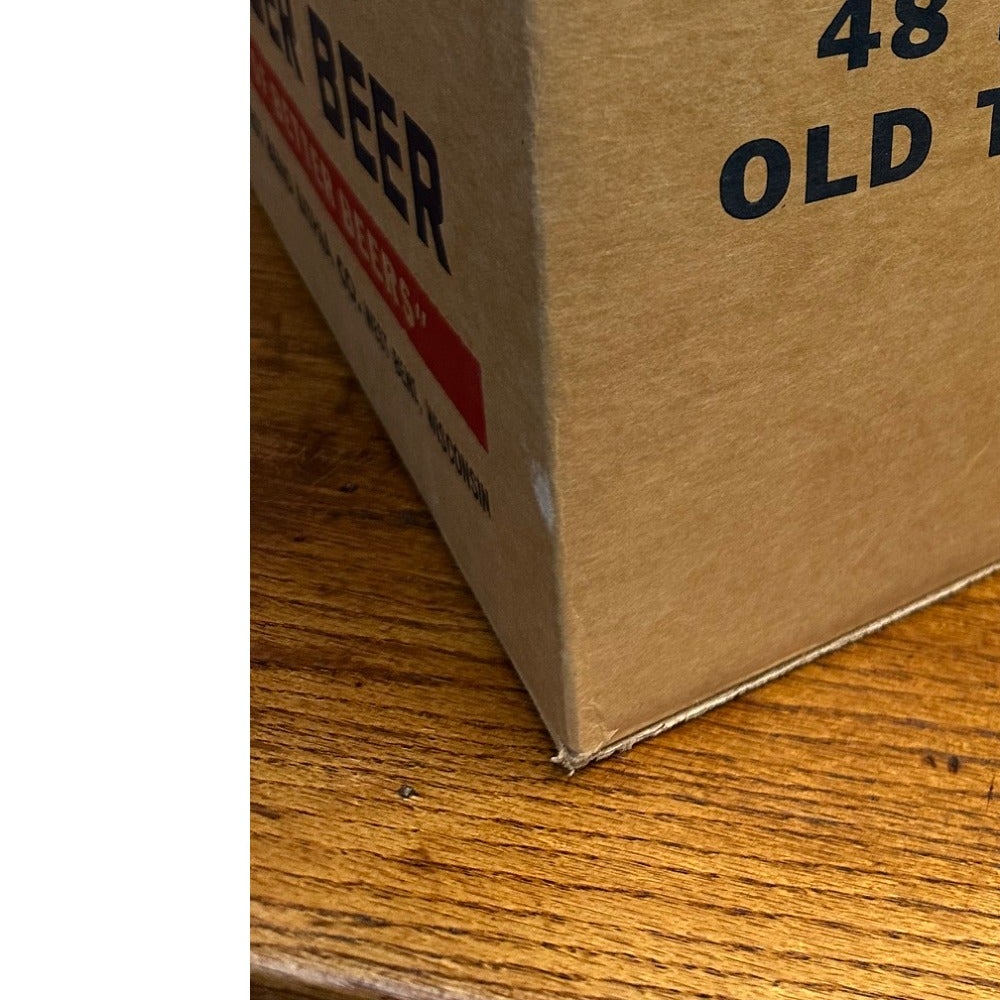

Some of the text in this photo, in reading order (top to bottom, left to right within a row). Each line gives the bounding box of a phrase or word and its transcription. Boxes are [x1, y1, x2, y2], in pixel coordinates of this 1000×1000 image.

[307, 4, 452, 276] BEER
[718, 107, 933, 221] OLD
[425, 398, 492, 519] WISCONSIN
